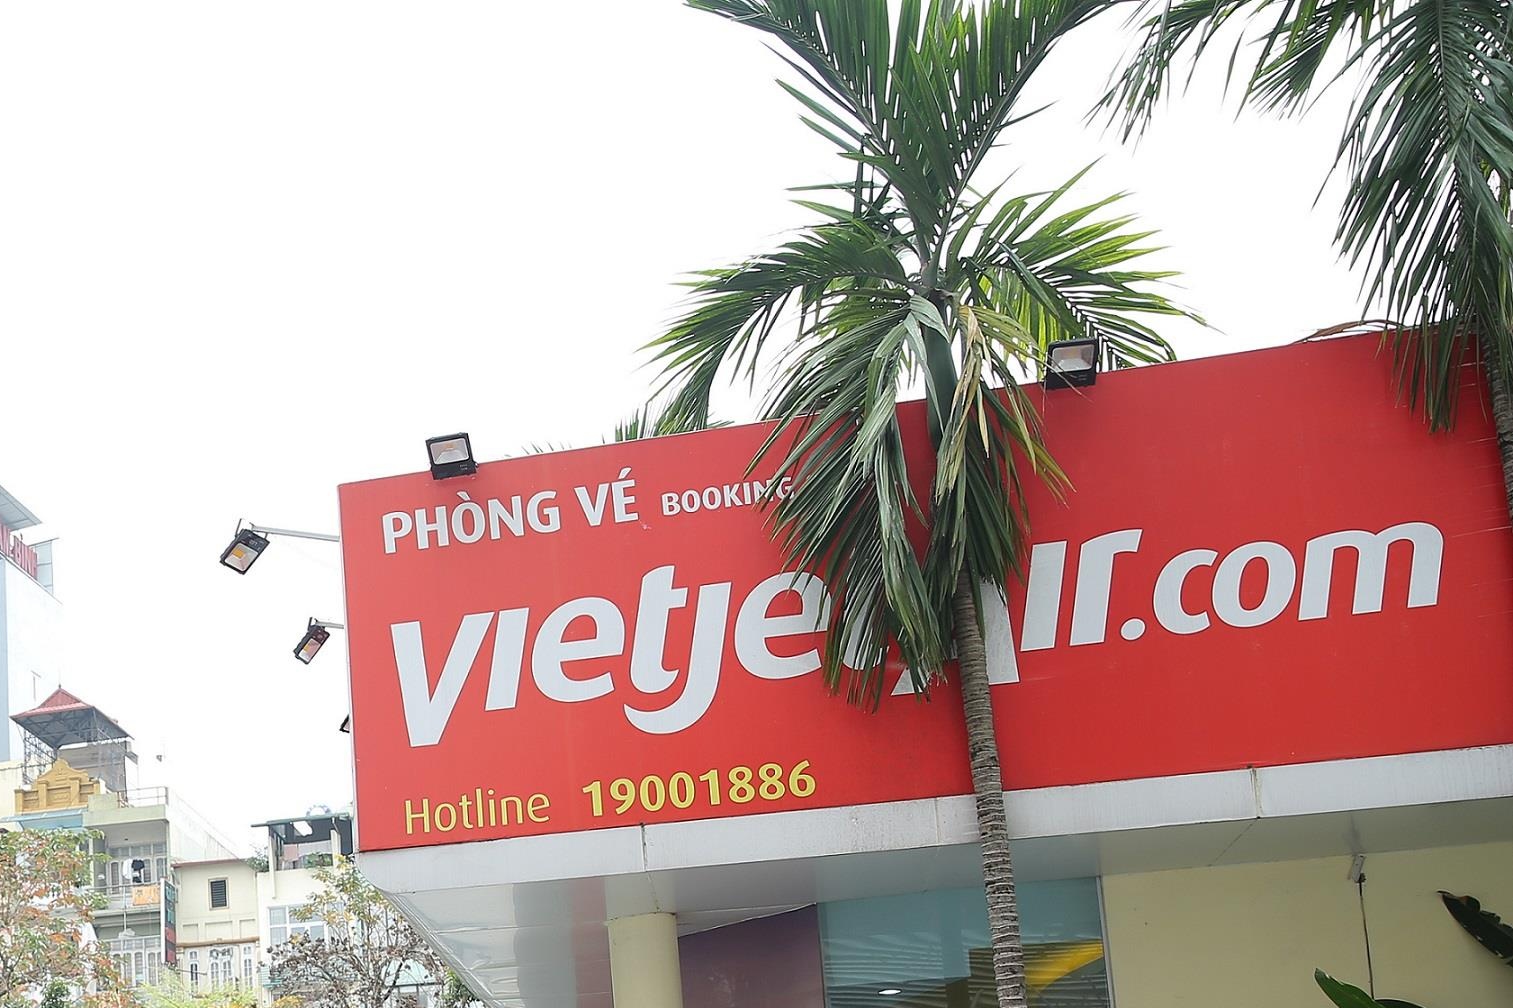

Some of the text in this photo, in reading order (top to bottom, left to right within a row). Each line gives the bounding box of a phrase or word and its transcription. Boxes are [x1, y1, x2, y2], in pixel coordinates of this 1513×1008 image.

[381, 466, 796, 555] PHÒNG VÉ BOOKING
[404, 760, 817, 835] Hotline 19001886
